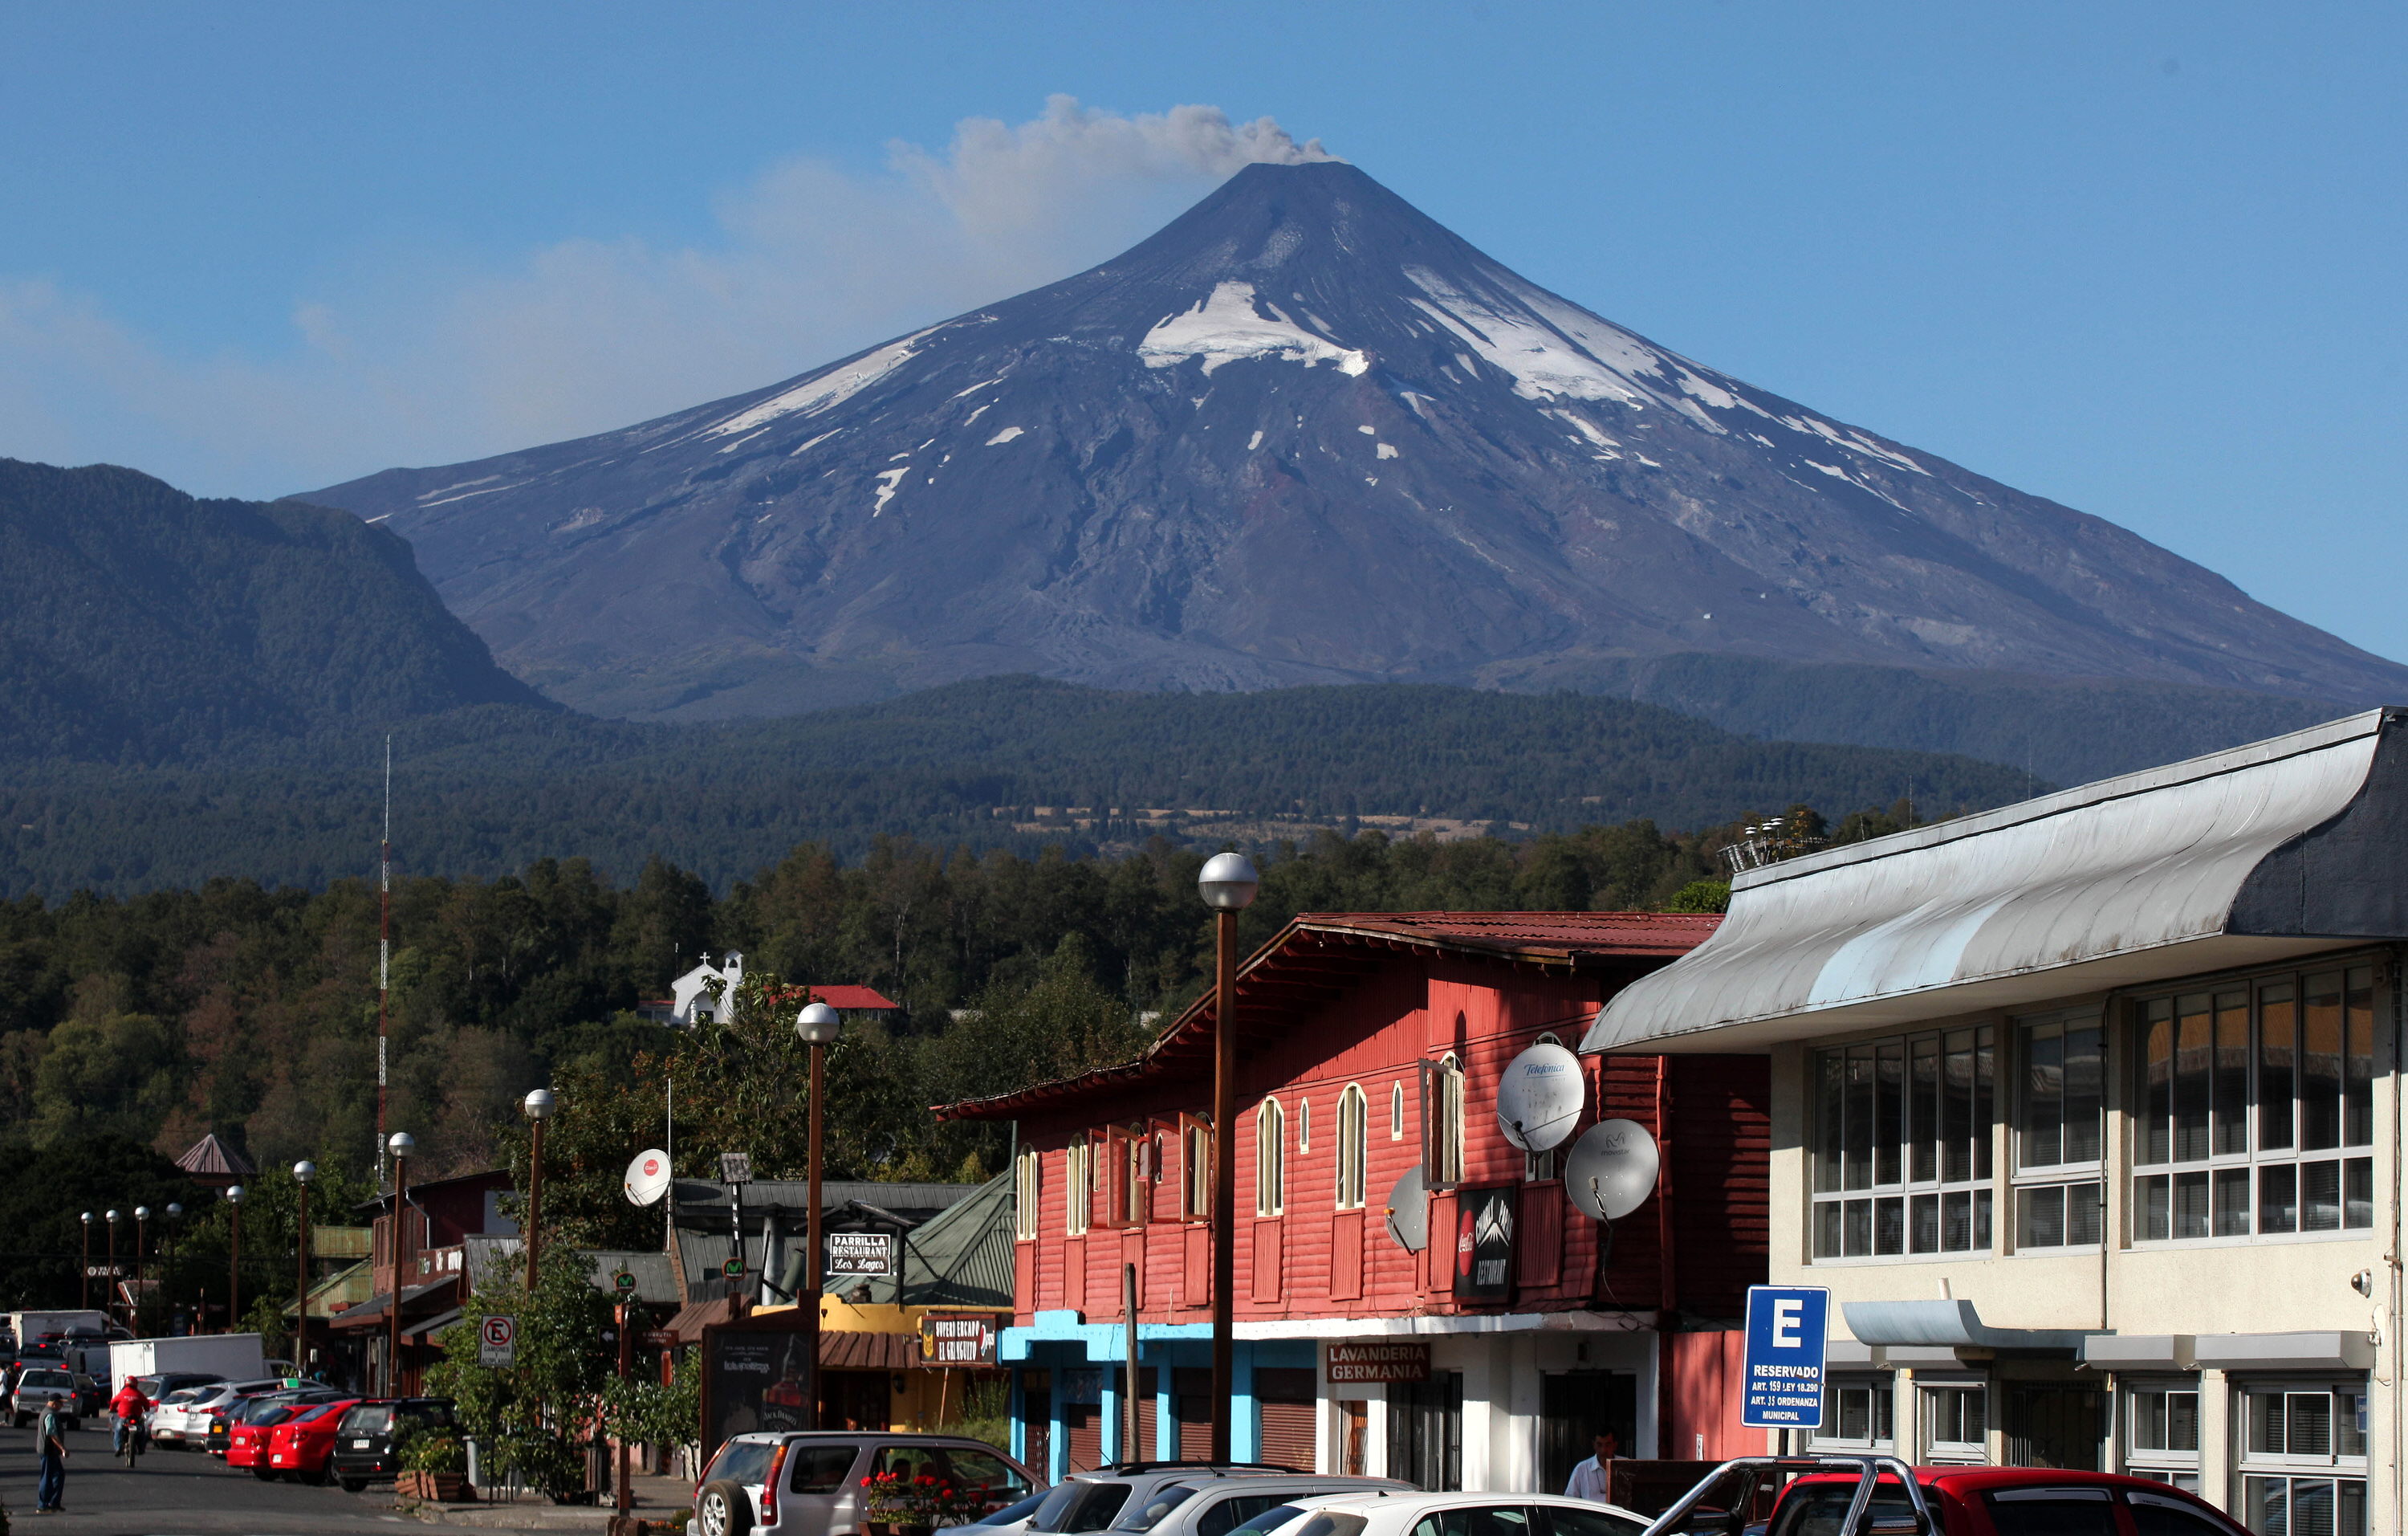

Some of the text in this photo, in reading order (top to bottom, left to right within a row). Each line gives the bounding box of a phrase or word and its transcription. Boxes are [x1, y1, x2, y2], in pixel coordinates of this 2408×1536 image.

[835, 1237, 885, 1246] PARRILLA
[832, 1246, 888, 1257] RESTAURANT
[835, 1257, 885, 1272] Los Lagos
[1772, 1299, 1803, 1347] E
[939, 1341, 977, 1361] EL GRINGUITO
[1330, 1347, 1426, 1362] LAVANDERIA
[1332, 1365, 1423, 1379] GERMANIA
[1754, 1365, 1819, 1378] RESERVADO
[1752, 1381, 1818, 1392] ART. 159 LEY 18.290
[1751, 1395, 1818, 1407] ART. 35 ORDENANZA
[1762, 1410, 1800, 1420] MUNICIPAL
